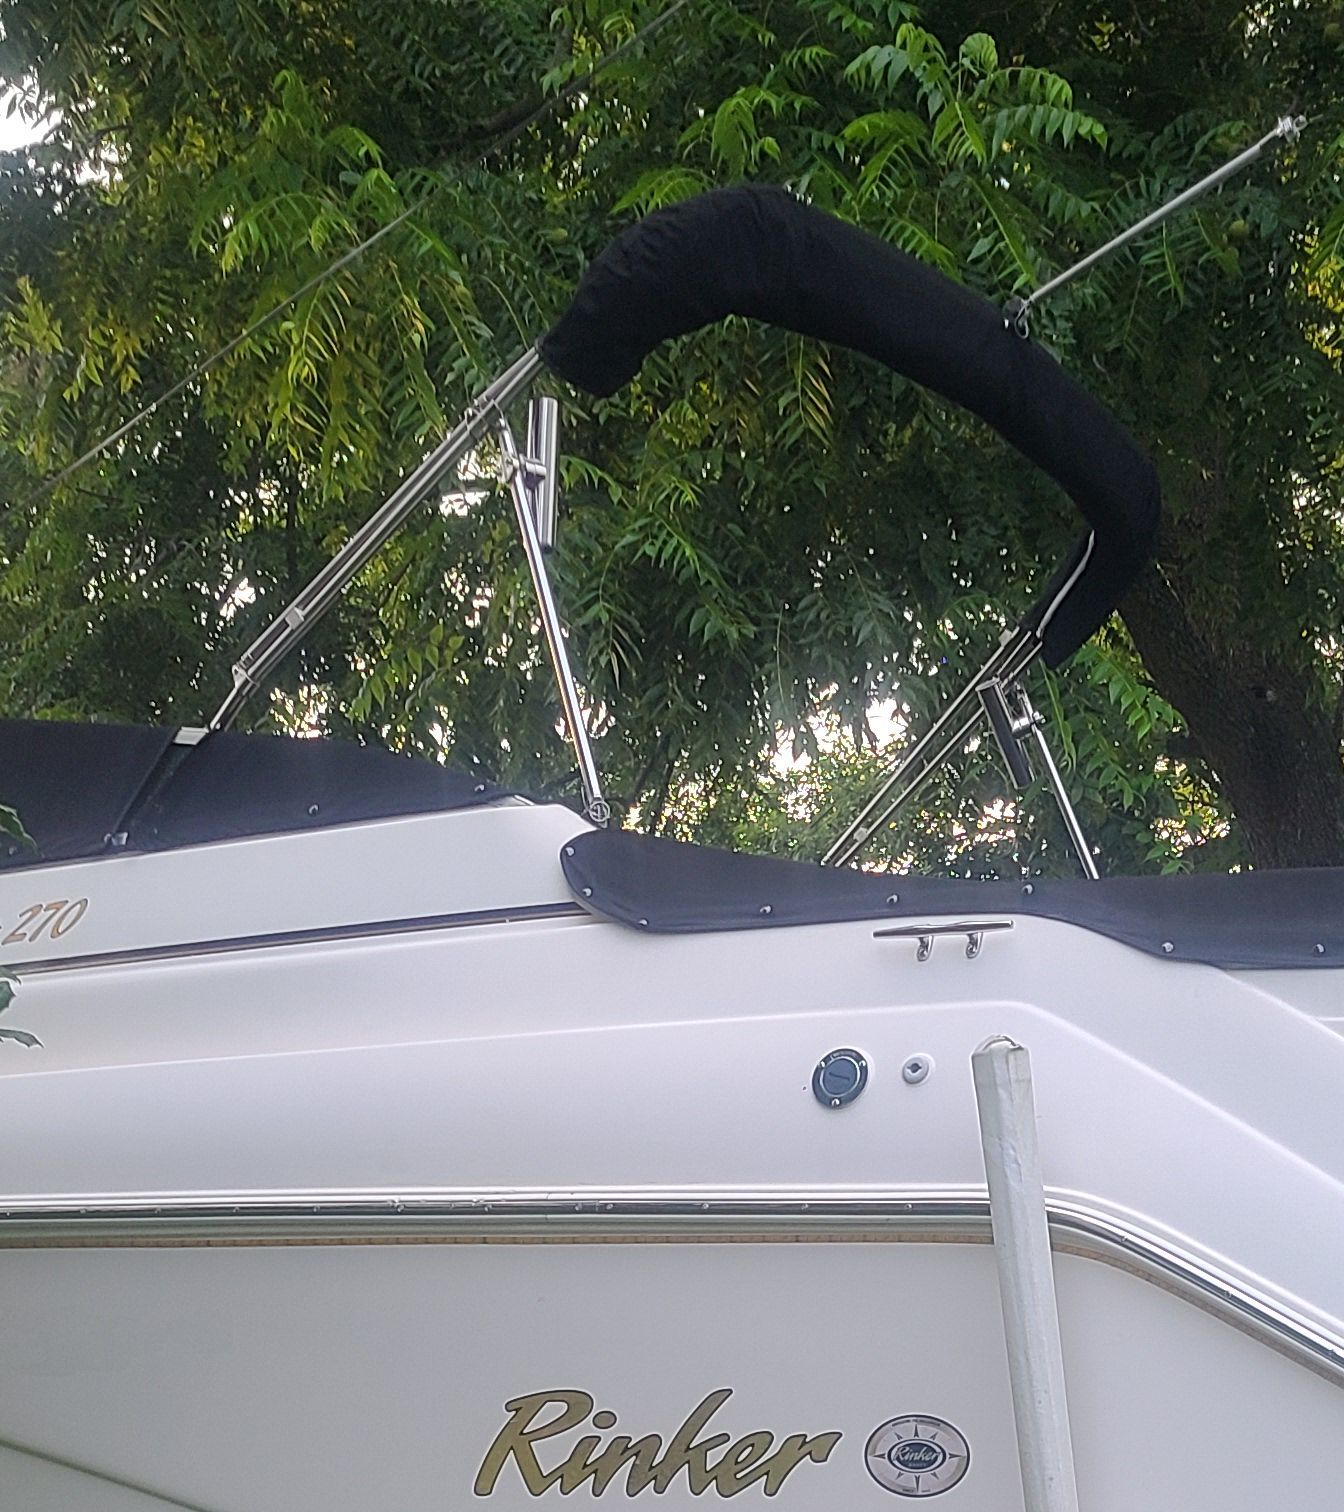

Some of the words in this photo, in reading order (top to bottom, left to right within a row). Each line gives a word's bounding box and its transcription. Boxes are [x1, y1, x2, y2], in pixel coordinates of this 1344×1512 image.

[1, 898, 89, 946] 270
[473, 1388, 843, 1498] Rinker
[893, 1446, 942, 1461] Rinker
